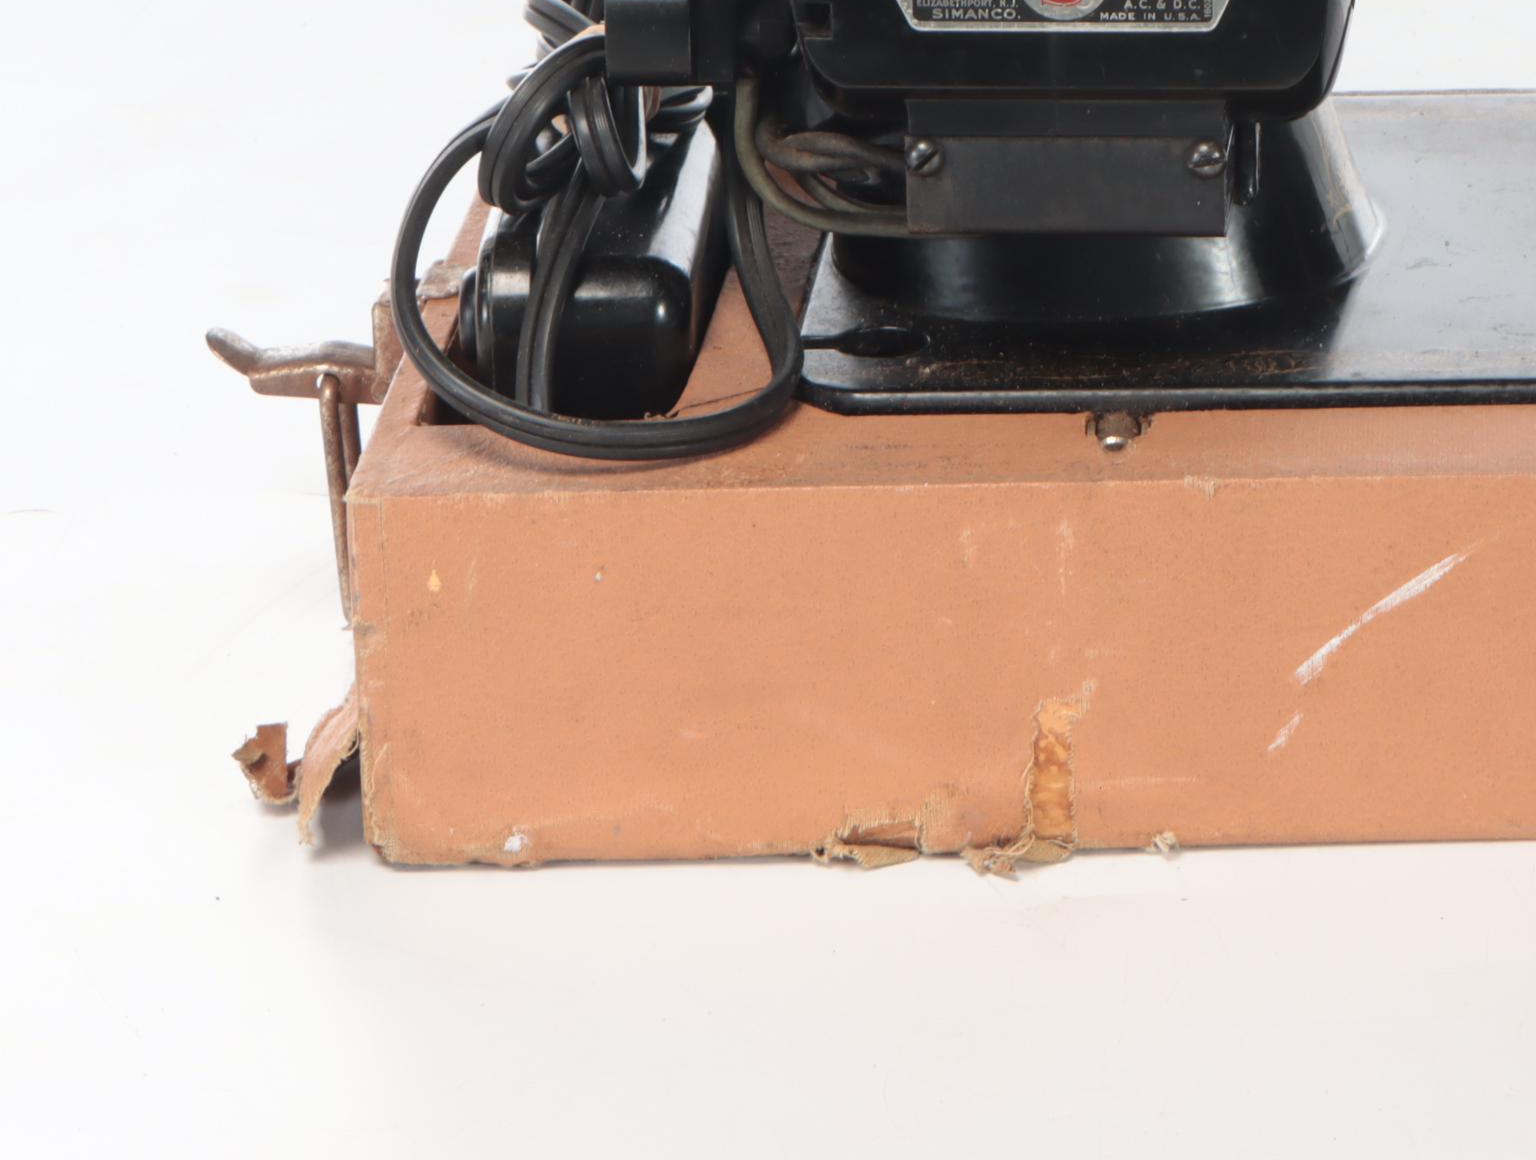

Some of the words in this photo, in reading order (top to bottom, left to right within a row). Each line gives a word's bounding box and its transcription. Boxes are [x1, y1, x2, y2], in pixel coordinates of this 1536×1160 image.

[1124, 0, 1152, 9] A.C.
[1156, 0, 1166, 8] &
[1173, 0, 1201, 9] D.C.
[932, 8, 1021, 20] SIMANCO.
[1100, 12, 1135, 21] MADE
[1143, 12, 1156, 20] IN
[1164, 12, 1201, 20] U.S.A.
